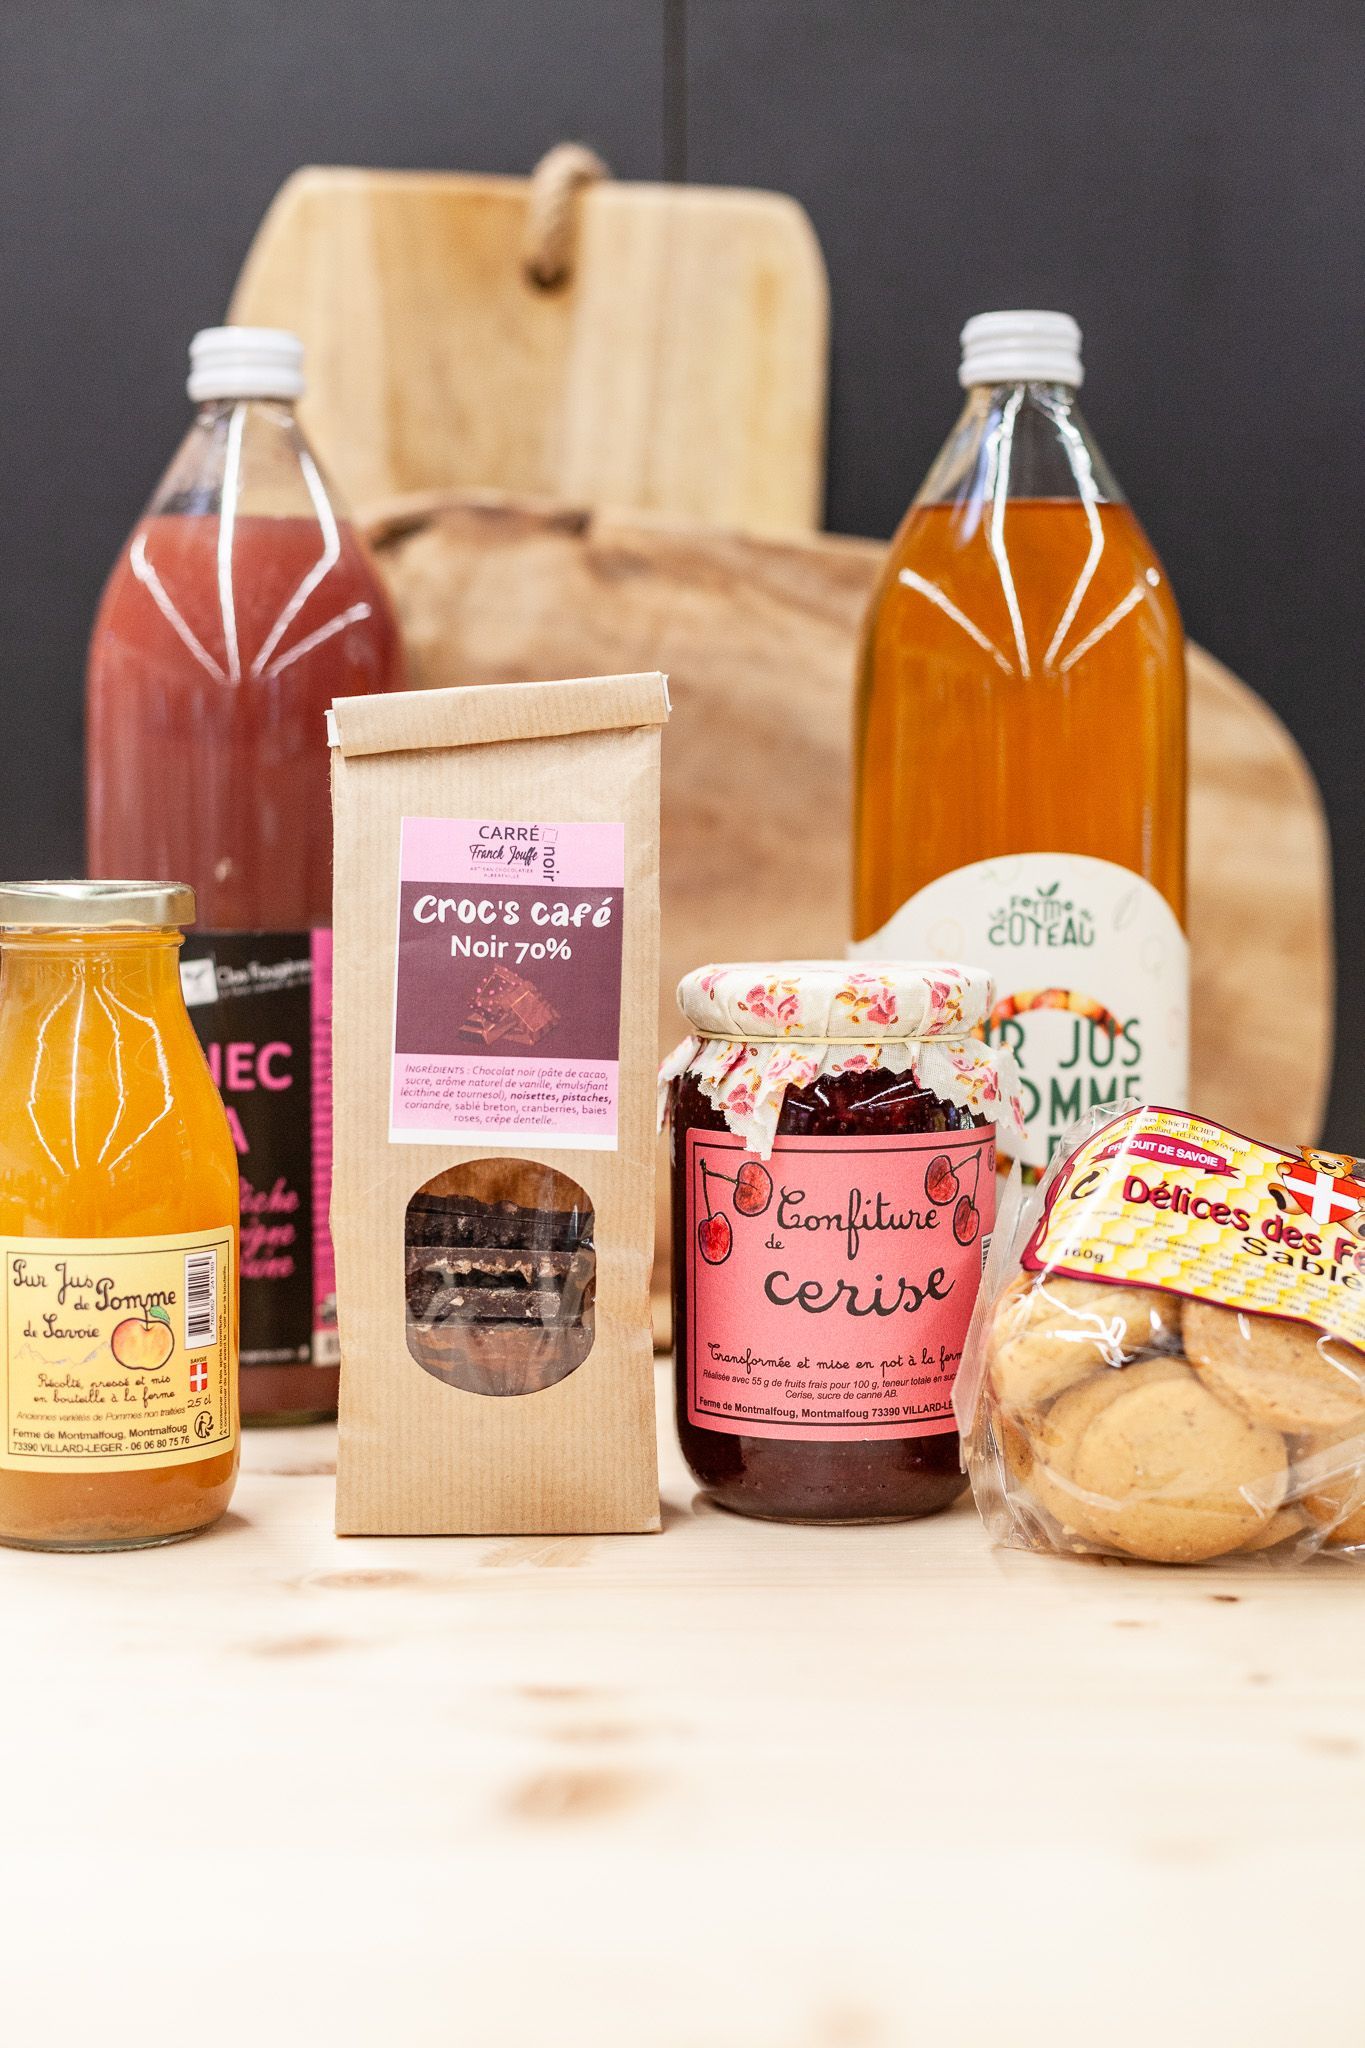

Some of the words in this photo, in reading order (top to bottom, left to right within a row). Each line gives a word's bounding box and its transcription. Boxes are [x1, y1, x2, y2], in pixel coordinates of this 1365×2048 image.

[478, 825, 540, 841] CARRÉ
[469, 844, 505, 861] Franck
[507, 845, 538, 866] Jouffe
[543, 846, 560, 882] noir
[413, 895, 520, 925] Croc's
[530, 897, 613, 928] café
[451, 934, 509, 958] Noir
[514, 937, 572, 964] 70%
[1059, 1018, 1142, 1069] JUS
[472, 1065, 515, 1076] Chocolat
[517, 1067, 535, 1076] noir
[537, 1067, 563, 1079] (pâte
[565, 1068, 577, 1078] de
[578, 1071, 609, 1080] cacao,
[406, 1078, 432, 1087] sucre,
[435, 1076, 466, 1086] arôme
[468, 1078, 503, 1087] naturel
[505, 1079, 517, 1088] de
[520, 1080, 552, 1090] vanille,
[556, 1080, 609, 1092] émulsifiant
[400, 1087, 440, 1097] lécithine
[443, 1088, 455, 1097] de
[456, 1090, 507, 1101] tournesol),
[510, 1091, 559, 1102] noisettes,
[561, 1092, 612, 1105] pistaches,
[405, 1101, 452, 1112] coriandre,
[455, 1102, 480, 1110] sablé
[484, 1103, 519, 1113] breton,
[521, 1104, 580, 1115] cranberries,
[582, 1105, 607, 1115] baies
[454, 1115, 483, 1124] roses,
[485, 1114, 511, 1125] crêpe
[1108, 1140, 1158, 1154] PRDUIT
[1158, 1144, 1175, 1156] DE
[1176, 1149, 1218, 1167] SAVOIE
[777, 1186, 941, 1260] Confiture
[764, 1233, 785, 1250] de
[1262, 1215, 1322, 1255] des
[1065, 1248, 1104, 1263] 160g
[13, 1258, 47, 1287] Pur
[55, 1261, 93, 1305] Jus
[764, 1267, 956, 1316] cerise
[74, 1295, 90, 1310] de
[95, 1277, 177, 1311] Pomme
[23, 1319, 37, 1338] de
[42, 1313, 101, 1338] Savoie
[190, 1356, 207, 1364] SAVOIE
[707, 1342, 791, 1374] Transformée
[796, 1357, 810, 1368] et
[816, 1359, 850, 1369] mise
[855, 1361, 874, 1369] en
[880, 1355, 904, 1378] pot
[908, 1355, 917, 1366] à
[921, 1347, 935, 1364] la
[90, 1377, 130, 1388] pressé
[135, 1376, 146, 1386] et
[151, 1375, 171, 1384] mis
[703, 1369, 730, 1382] Réalisée
[732, 1376, 750, 1384] avec
[751, 1377, 762, 1385] 55
[763, 1379, 769, 1388] g
[771, 1379, 782, 1387] de
[784, 1379, 806, 1388] fruits
[808, 1380, 828, 1389] frais
[829, 1381, 851, 1390] pour
[853, 1380, 869, 1389] 100
[872, 1381, 880, 1390] g,
[882, 1378, 909, 1388] teneur
[910, 1376, 931, 1386] totale
[33, 1395, 48, 1403] en
[53, 1388, 105, 1403] bouteille
[111, 1393, 119, 1403] à
[124, 1387, 137, 1402] la
[142, 1386, 176, 1408] ferme
[187, 1397, 202, 1408] 25
[203, 1394, 212, 1405] cl
[785, 1390, 815, 1400] Cerise,
[817, 1392, 841, 1400] sucre
[843, 1391, 854, 1400] de
[856, 1391, 882, 1399] canne
[884, 1389, 898, 1398] AB.
[16, 1411, 57, 1421] Anciennes
[59, 1413, 90, 1421] variétés
[93, 1412, 104, 1421] de
[105, 1411, 142, 1421] Pommes
[143, 1410, 159, 1419] non
[160, 1407, 186, 1417] traitées
[699, 1396, 720, 1408] Ferme
[722, 1402, 732, 1410] de
[734, 1403, 798, 1419] Montmalfoug,
[801, 1408, 869, 1419] Montmalfoug
[872, 1407, 900, 1417] 73390
[13, 1428, 40, 1439] Ferme
[43, 1429, 55, 1439] de
[58, 1430, 126, 1441] Montmalfoug,
[129, 1424, 188, 1438] Montmalfoug
[13, 1442, 38, 1452] 73390
[40, 1442, 123, 1453] VILLARD-LEGER
[130, 1442, 142, 1451] 06
[144, 1440, 154, 1450] 06
[157, 1439, 167, 1448] 80
[169, 1437, 179, 1446] 75
[181, 1435, 190, 1444] 76
